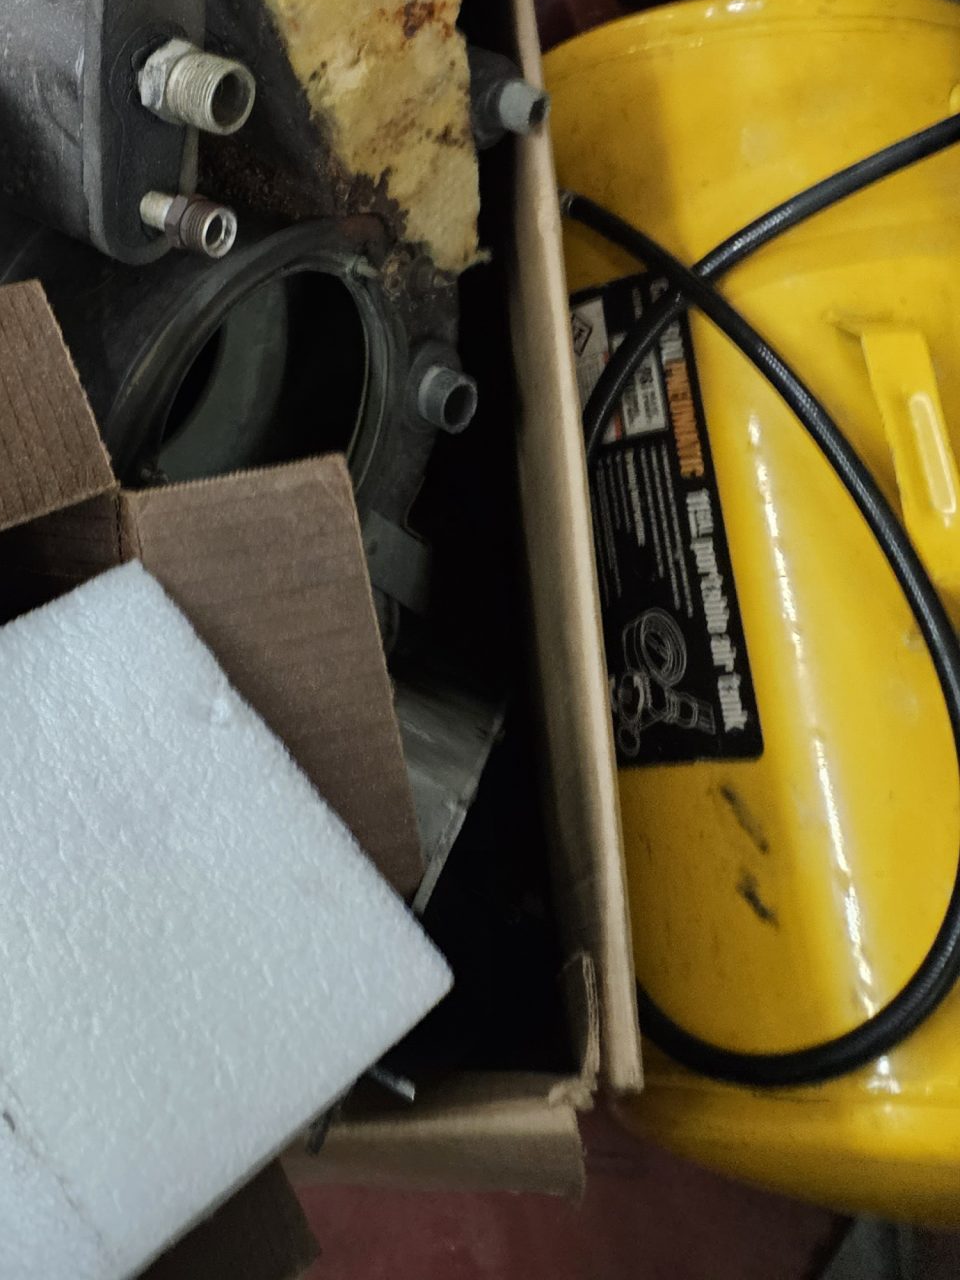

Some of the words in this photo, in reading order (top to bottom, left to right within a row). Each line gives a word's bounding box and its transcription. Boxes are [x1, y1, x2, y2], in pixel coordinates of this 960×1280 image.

[691, 537, 730, 634] portable
[711, 634, 737, 672] air
[718, 673, 748, 733] tank
